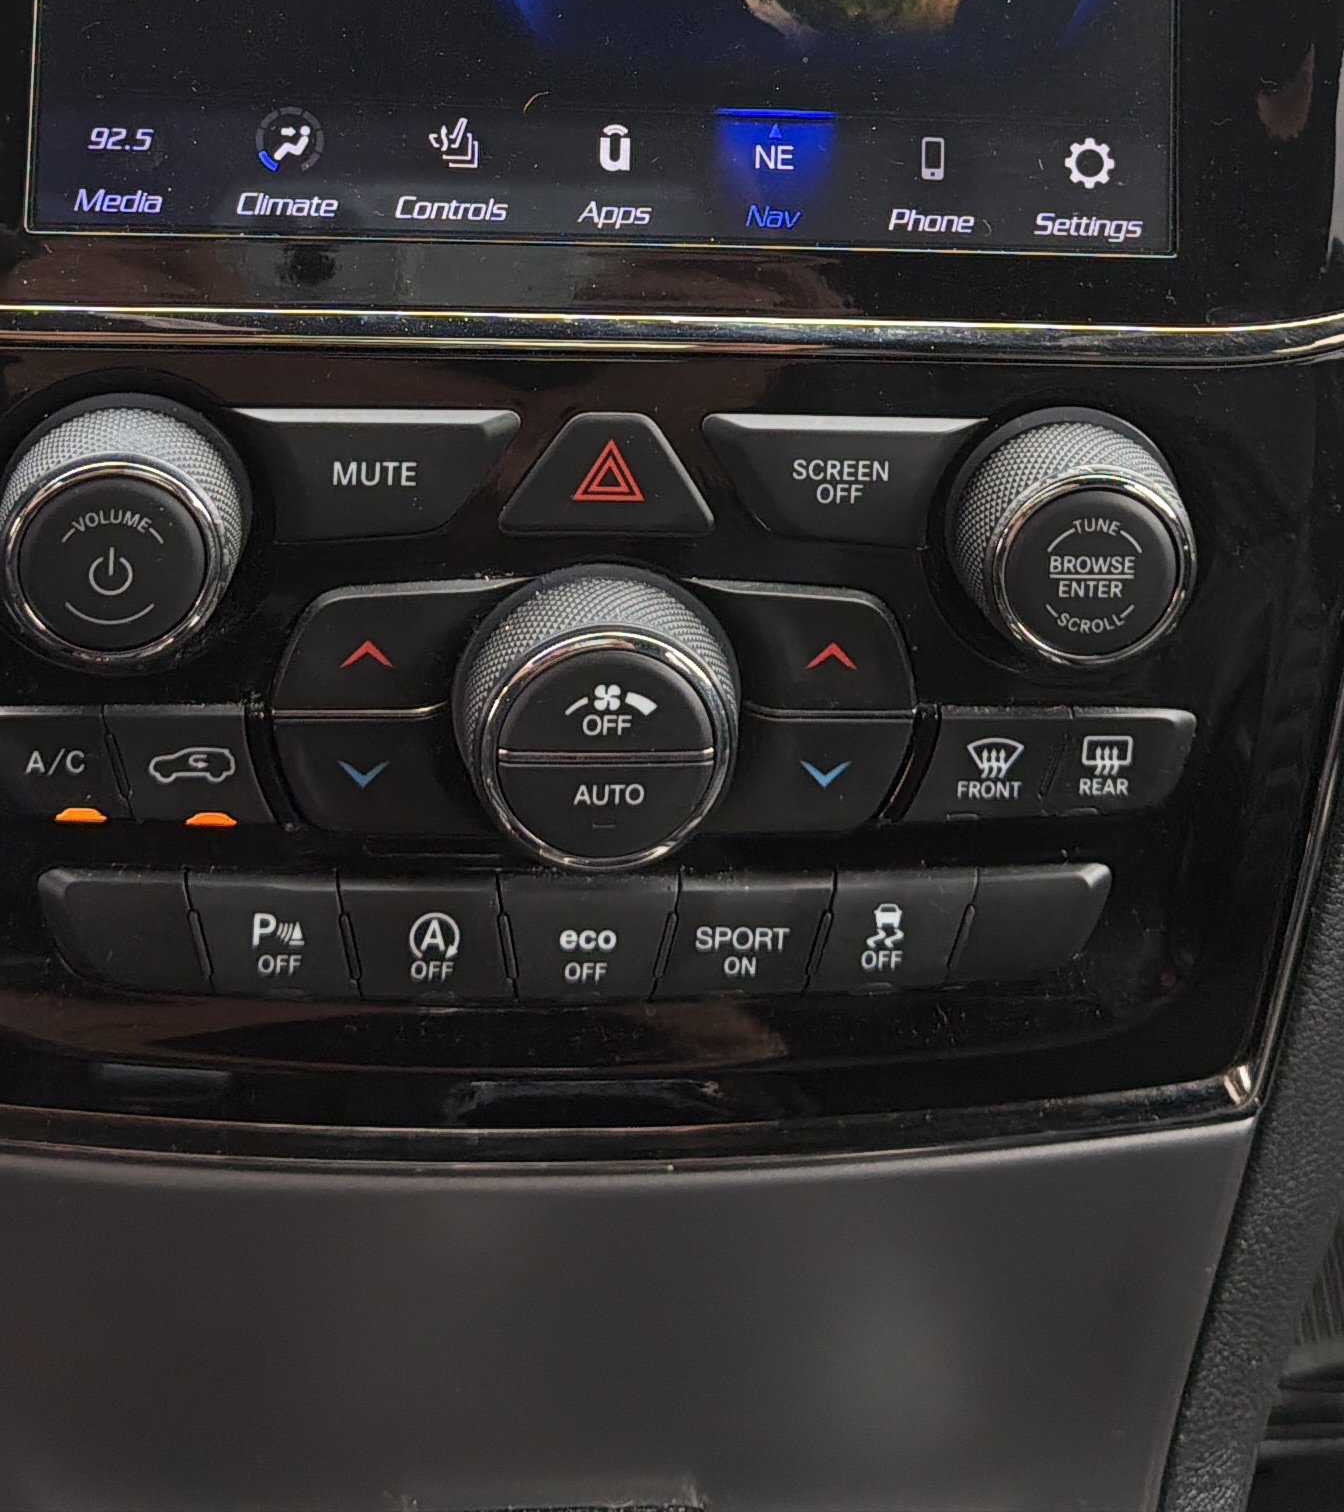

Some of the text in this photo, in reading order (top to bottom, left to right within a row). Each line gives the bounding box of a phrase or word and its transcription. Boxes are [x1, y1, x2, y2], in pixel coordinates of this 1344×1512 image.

[87, 127, 155, 151] 92.5
[754, 144, 794, 170] NE
[73, 188, 163, 214] Media
[236, 192, 339, 218] Climate
[394, 195, 509, 221] Controls
[577, 200, 653, 230] Apps
[745, 204, 801, 229] Nav
[888, 208, 975, 234] Phone
[1033, 212, 1144, 243] Settings
[332, 461, 417, 487] MUTE
[792, 459, 889, 482] SCREEN
[816, 483, 864, 504] OFF
[71, 508, 152, 533] VOLUME
[1071, 514, 1124, 538] TUNE
[1049, 555, 1136, 574] BROWSE
[1058, 580, 1123, 598] ENTER
[1056, 610, 1127, 634] SCROLL
[582, 714, 633, 736] OFF
[25, 748, 85, 775] A/C
[573, 783, 645, 806] AUTO
[957, 780, 1022, 799] FRONT
[1079, 777, 1129, 796] REAR
[252, 912, 277, 947] P
[559, 929, 617, 950] eco
[695, 926, 790, 951] SPORT
[257, 954, 302, 974] OFF
[410, 960, 454, 980] OFF
[564, 961, 608, 982] OFF
[723, 956, 757, 977] ON
[860, 950, 903, 970] OFF
